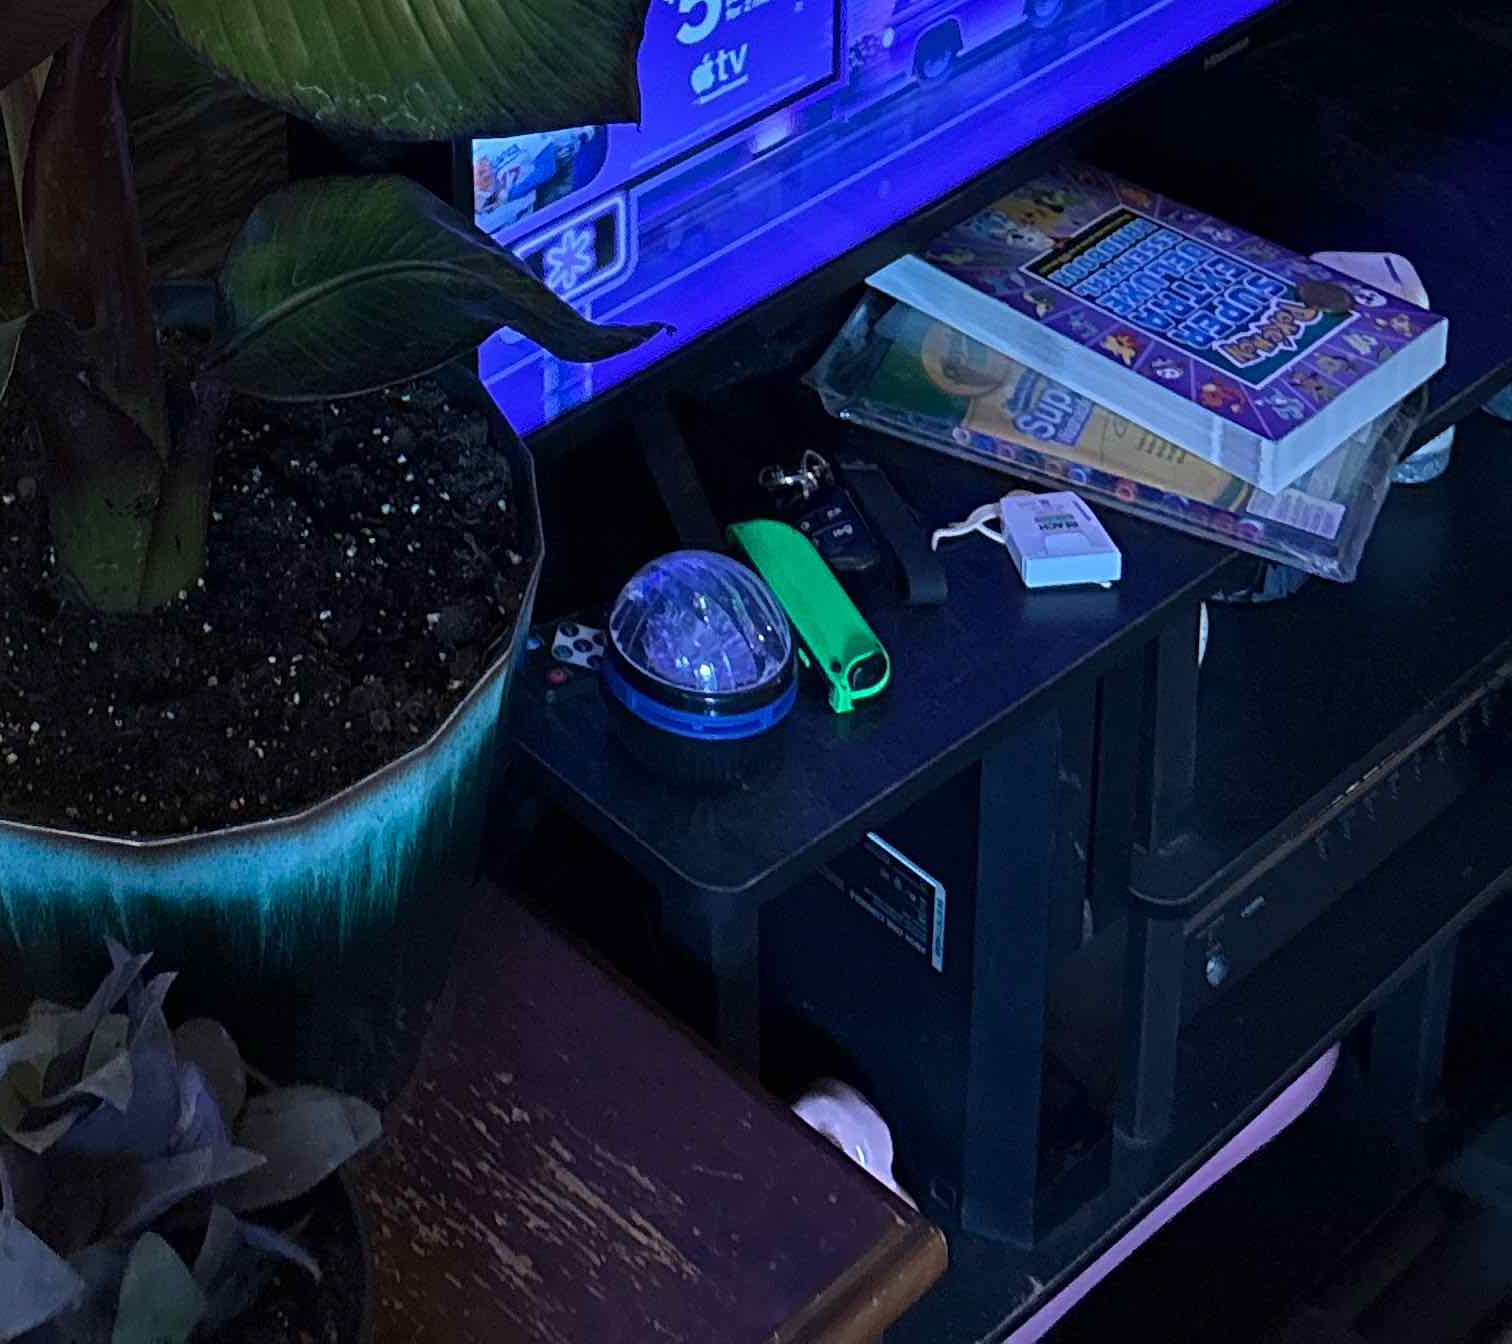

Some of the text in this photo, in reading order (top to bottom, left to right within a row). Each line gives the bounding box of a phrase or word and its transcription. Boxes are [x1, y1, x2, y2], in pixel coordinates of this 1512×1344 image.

[716, 43, 748, 81] tv
[1096, 239, 1214, 313] DELUXE
[1129, 255, 1249, 330] EXTRA
[1167, 272, 1287, 348] SUPER
